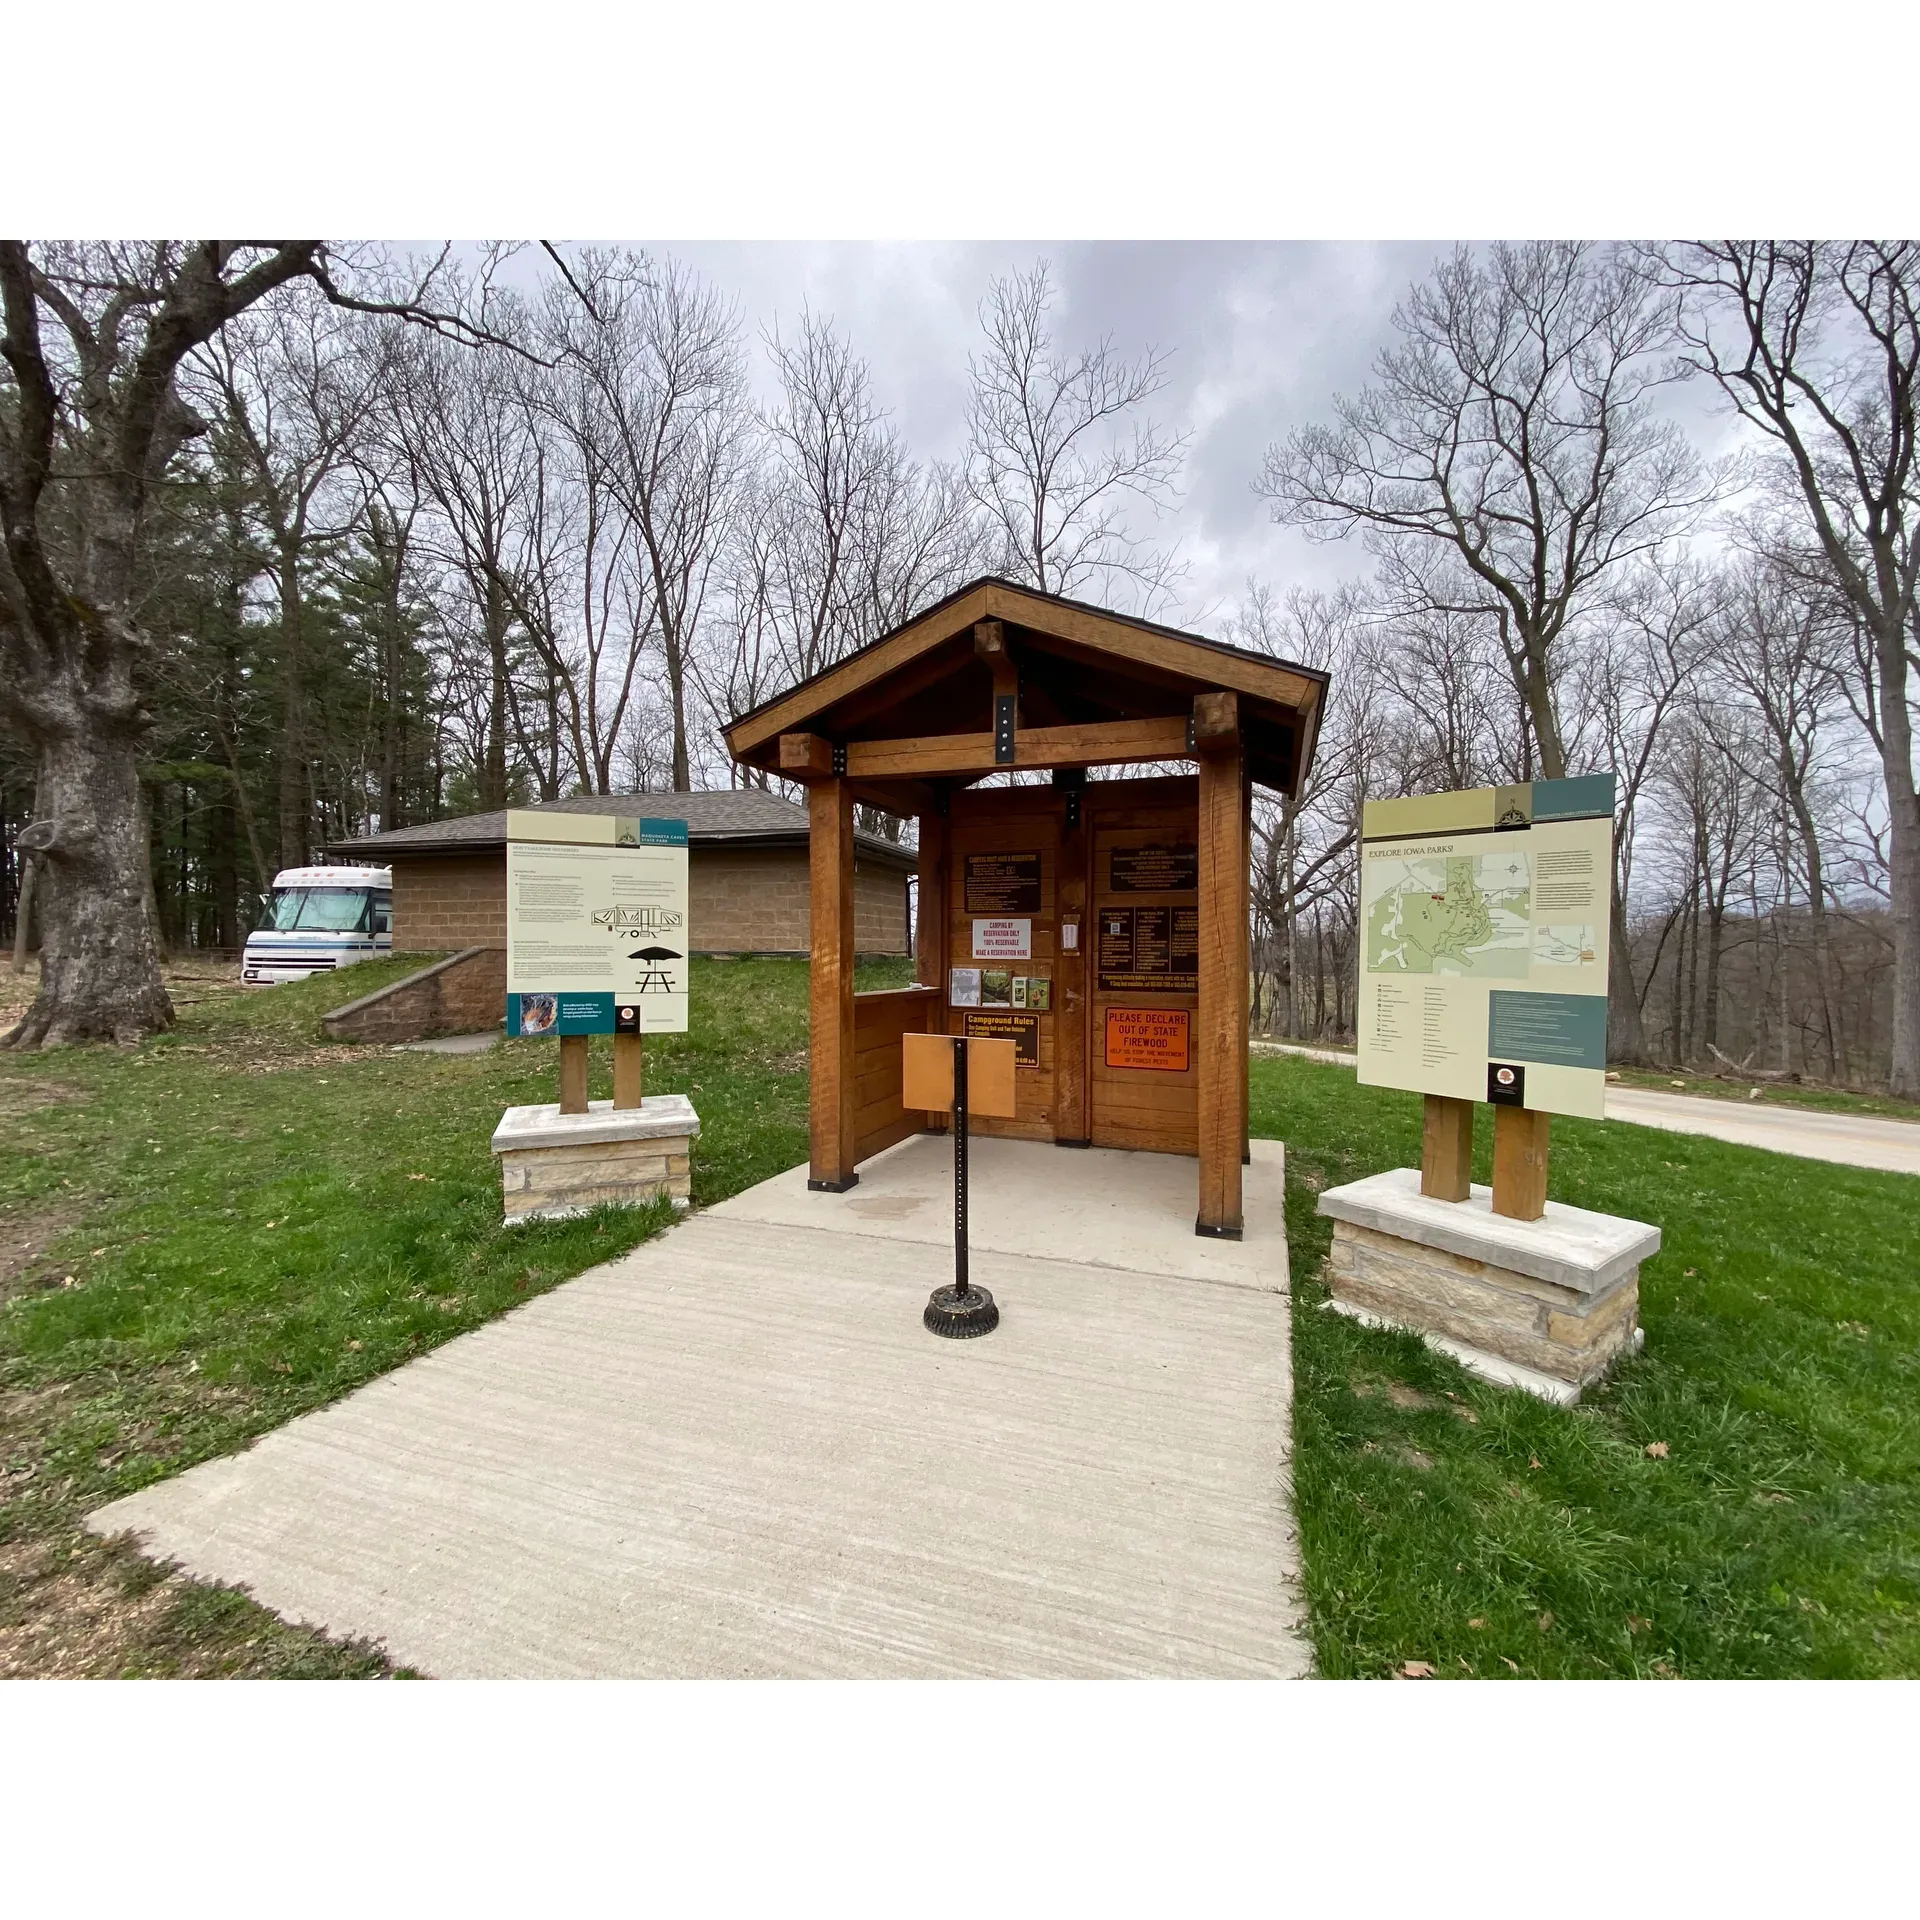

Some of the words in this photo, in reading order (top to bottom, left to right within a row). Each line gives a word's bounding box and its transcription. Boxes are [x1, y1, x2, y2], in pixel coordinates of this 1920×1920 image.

[1369, 849, 1401, 858] EXPLORE
[1403, 848, 1425, 856] IOWA
[1427, 845, 1454, 854] PARKS!
[968, 1015, 1012, 1025] Campground
[1014, 1017, 1035, 1025] Rules
[1109, 1013, 1142, 1023] PLEASE
[1146, 1014, 1186, 1024] DECLARE
[1118, 1025, 1136, 1034] OUT
[1138, 1025, 1150, 1035] OF
[1153, 1026, 1179, 1036] STATE
[1123, 1037, 1168, 1048] FIREWOOD
